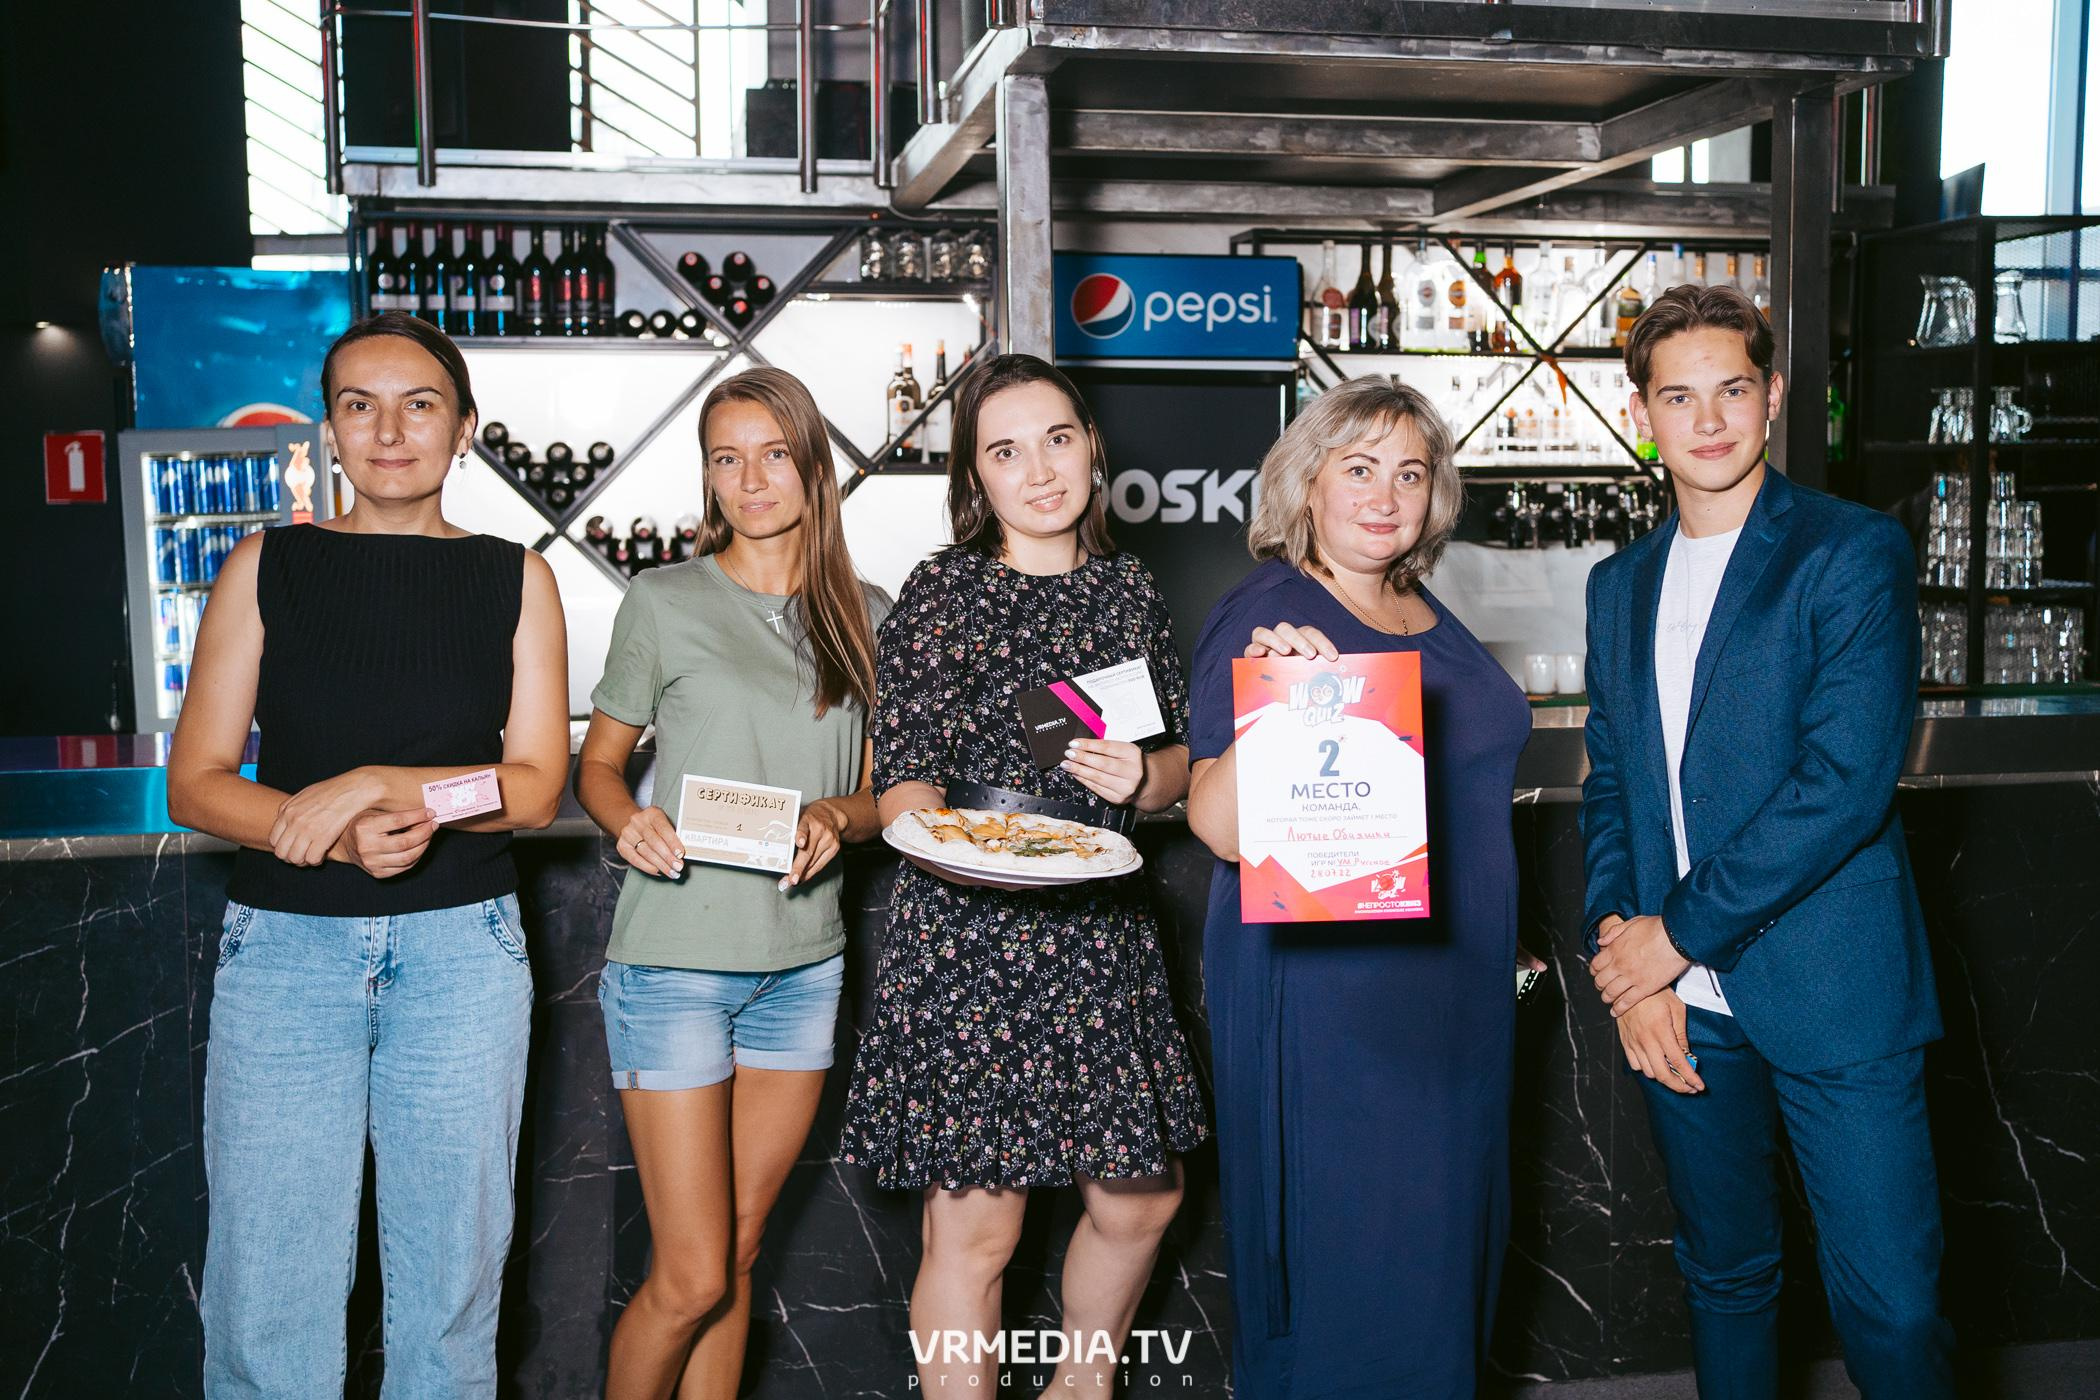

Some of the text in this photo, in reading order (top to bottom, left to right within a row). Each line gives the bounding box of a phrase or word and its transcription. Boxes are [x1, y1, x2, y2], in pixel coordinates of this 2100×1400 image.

[1144, 285, 1272, 332] pepsi
[1102, 468, 1259, 523] OSK
[1303, 703, 1344, 727] QUIZ
[1318, 739, 1340, 777] 2
[429, 784, 442, 792] 50%
[443, 781, 463, 790] СКИДКА
[1291, 781, 1371, 800] МЕСТО
[697, 787, 786, 811] СЕРТИФИКАТ
[1307, 850, 1360, 859] ПОБЕДИТЕЛИ
